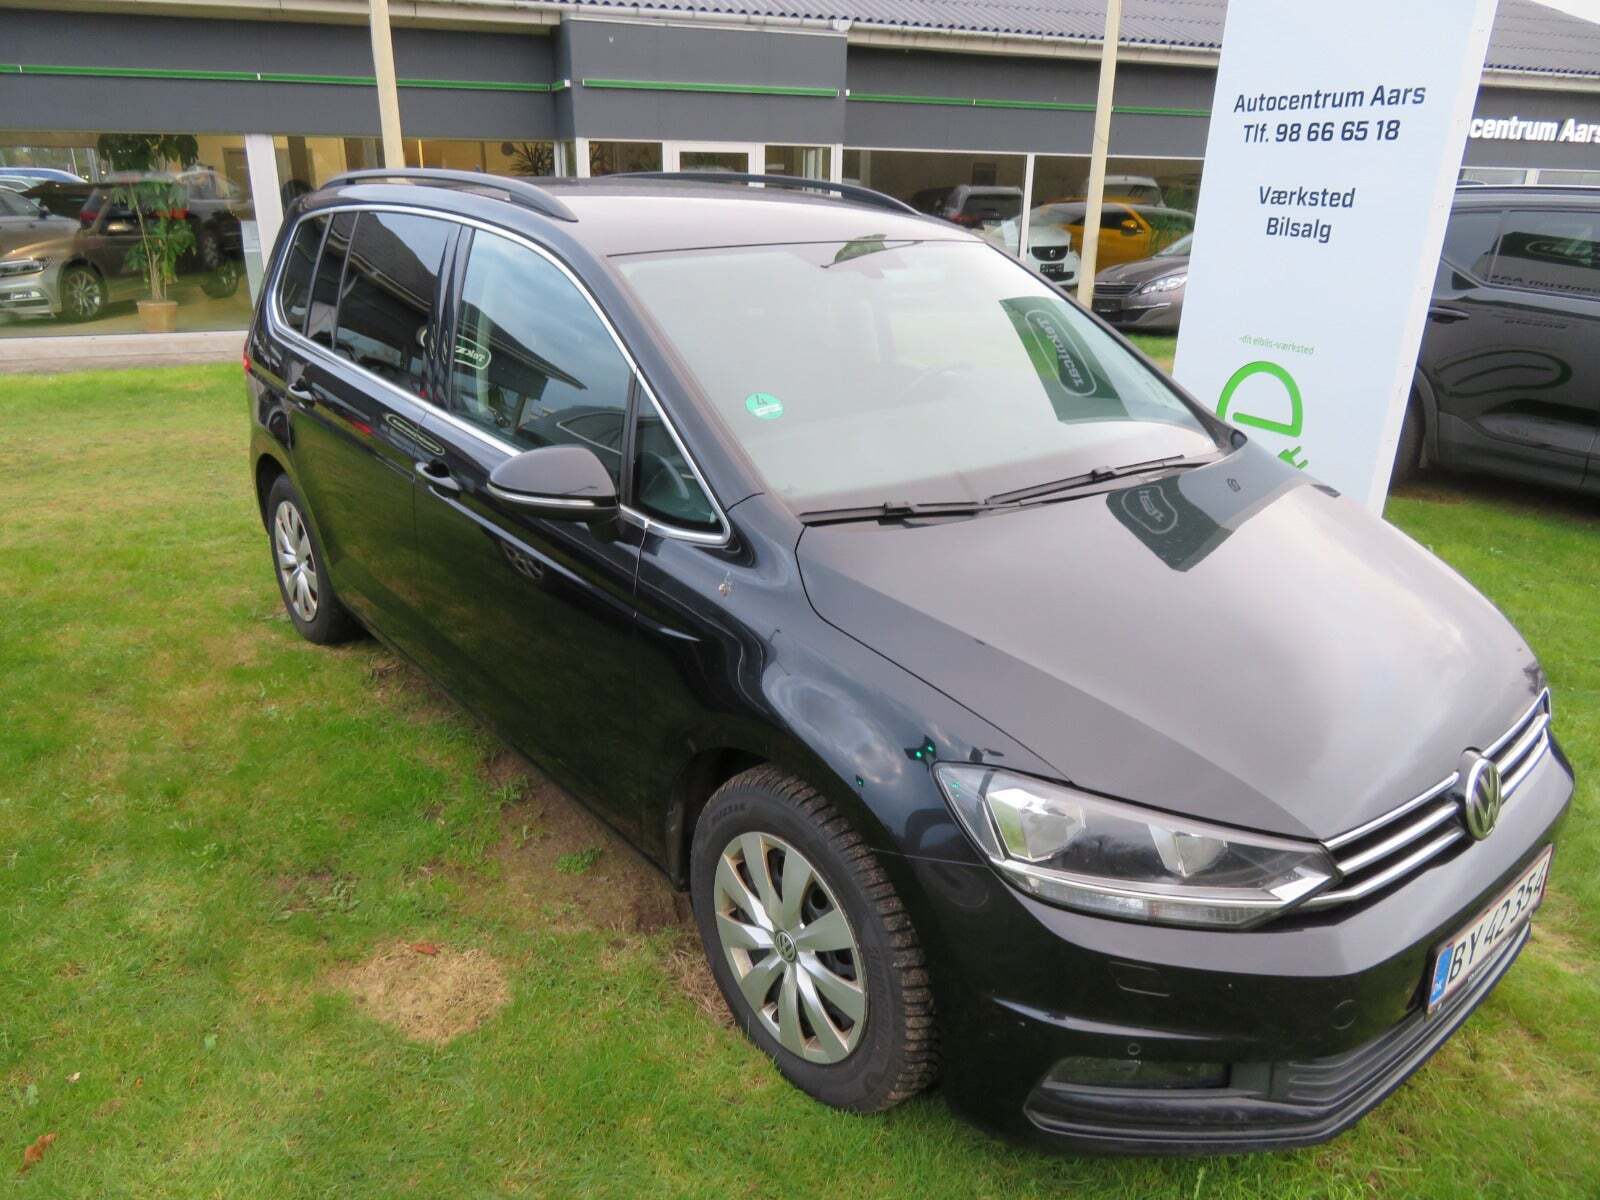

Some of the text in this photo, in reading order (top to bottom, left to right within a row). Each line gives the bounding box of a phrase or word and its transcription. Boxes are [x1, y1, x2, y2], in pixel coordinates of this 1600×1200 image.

[1234, 84, 1427, 113] Autocentrum Aars
[1243, 119, 1401, 143] Tlf. 98 66 65 18
[1469, 115, 1558, 141] centrum
[1259, 185, 1356, 209] Værksted
[1266, 216, 1332, 244] Bilsalg
[1449, 924, 1483, 983] BY
[1484, 898, 1511, 945] 42
[1510, 861, 1548, 924] 354
